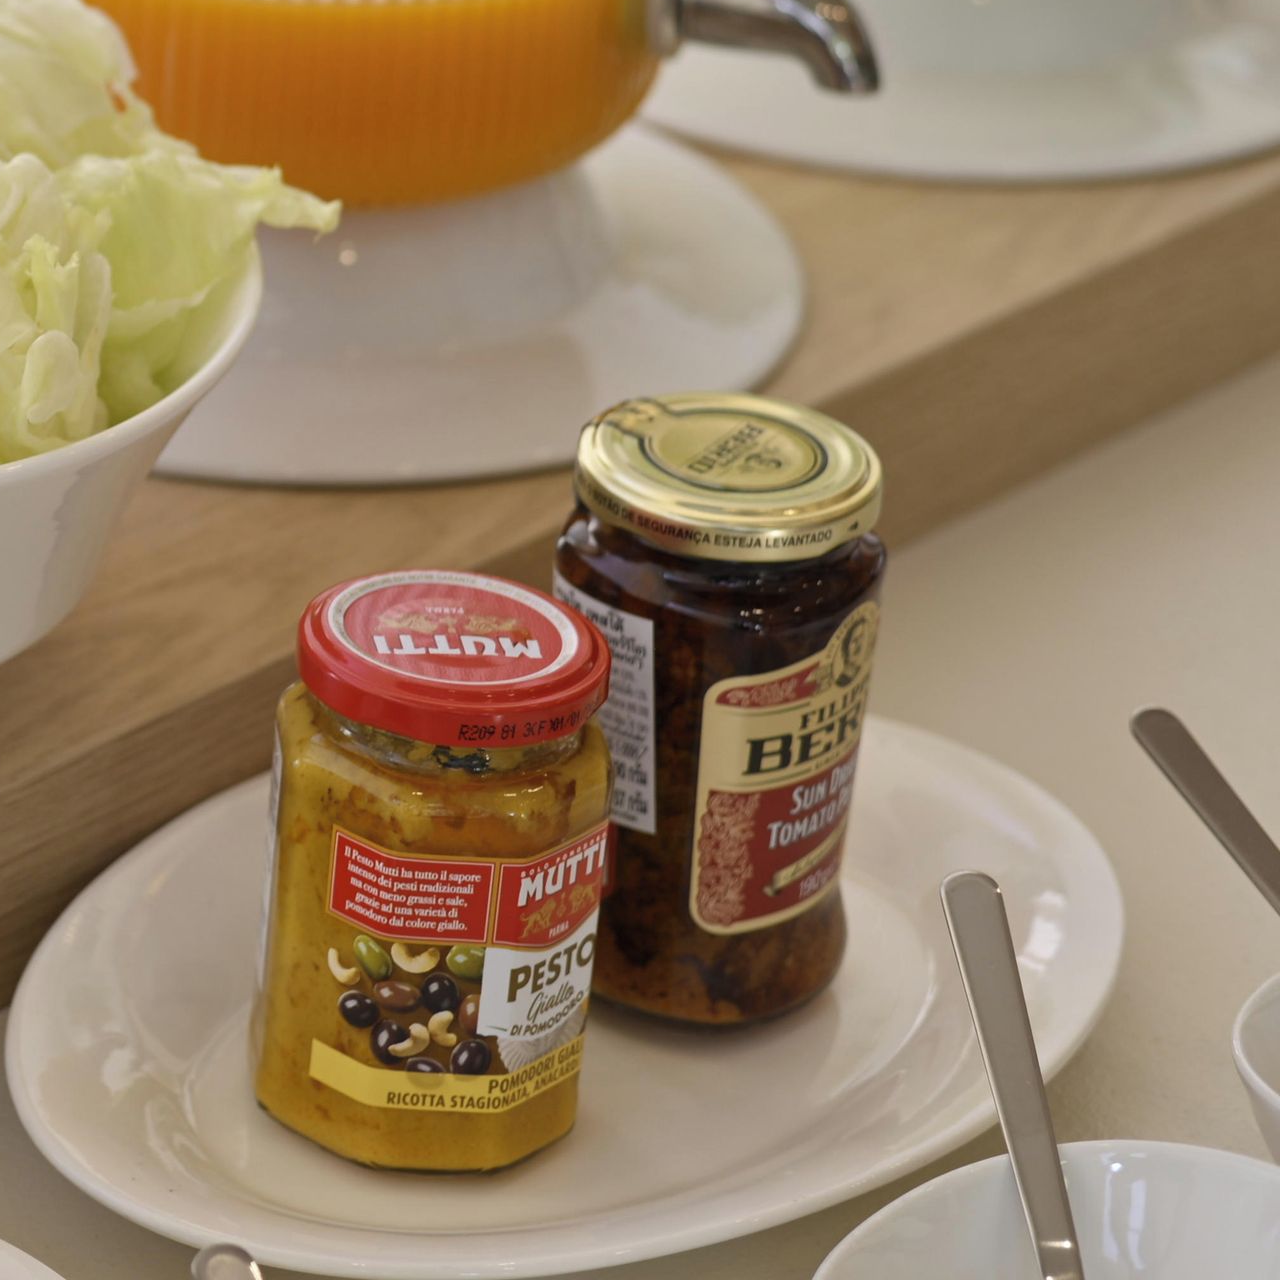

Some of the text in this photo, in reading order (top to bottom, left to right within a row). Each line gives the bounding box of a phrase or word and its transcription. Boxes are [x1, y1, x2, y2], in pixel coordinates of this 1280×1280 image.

[621, 506, 636, 524] DE
[637, 516, 710, 546] SEGURANÇA
[714, 534, 761, 548] ESTEJA
[766, 529, 832, 548] LEVANTADO
[373, 635, 542, 659] MUTTI
[790, 779, 827, 815] SUN
[768, 803, 835, 849] TOMATO
[348, 861, 473, 894] intenso dei pesti tradizionali
[352, 848, 373, 867] Pesto
[375, 860, 398, 876] Mutti
[402, 868, 412, 878] ha
[415, 869, 438, 879] tutto
[441, 871, 447, 880] il
[449, 874, 481, 884] sapore
[517, 839, 607, 907] MUTTI
[351, 876, 362, 888] ma
[364, 883, 378, 895] con
[380, 890, 406, 902] meno
[407, 895, 436, 906] grassi
[445, 896, 468, 907] sale,
[355, 892, 458, 918] grazie ad una varietà di
[345, 900, 467, 932] pomodoro dal colore giallo.
[507, 933, 597, 1003] PESTO
[510, 991, 583, 1036] DI POMODORO
[527, 982, 574, 1023] Giallo
[488, 1056, 555, 1094] POMODORI
[387, 1092, 445, 1107] RICOTTA
[450, 1086, 530, 1110] STAGIONATA,
